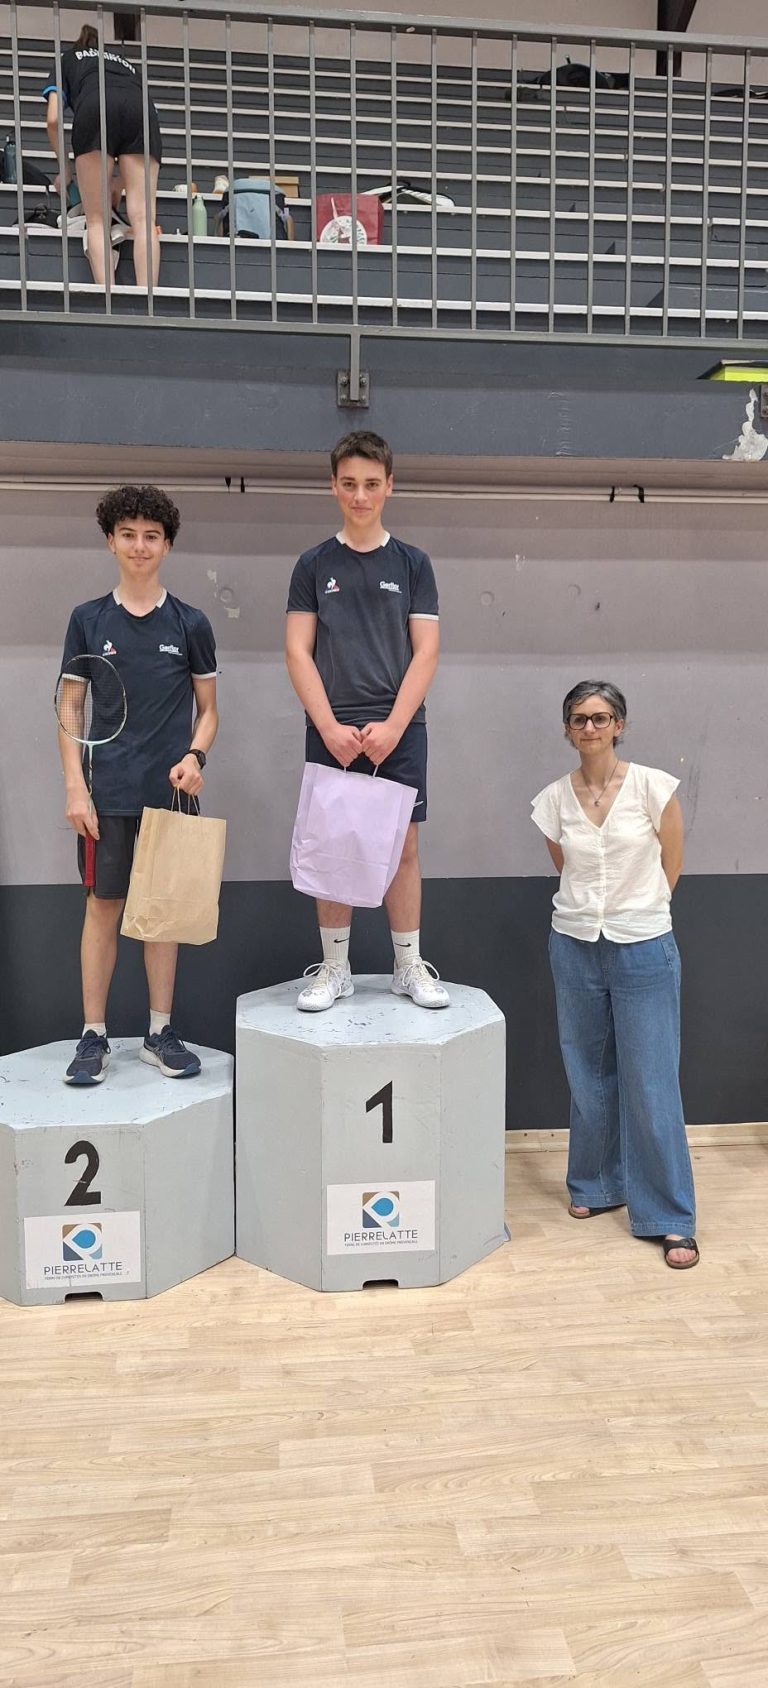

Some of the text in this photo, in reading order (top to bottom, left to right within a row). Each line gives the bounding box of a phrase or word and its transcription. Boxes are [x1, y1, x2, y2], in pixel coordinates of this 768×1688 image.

[366, 1080, 393, 1143] 1
[64, 1140, 101, 1206] 2
[344, 1229, 418, 1242] PIERRELATTE
[43, 1261, 123, 1275] PIERRELATTE
